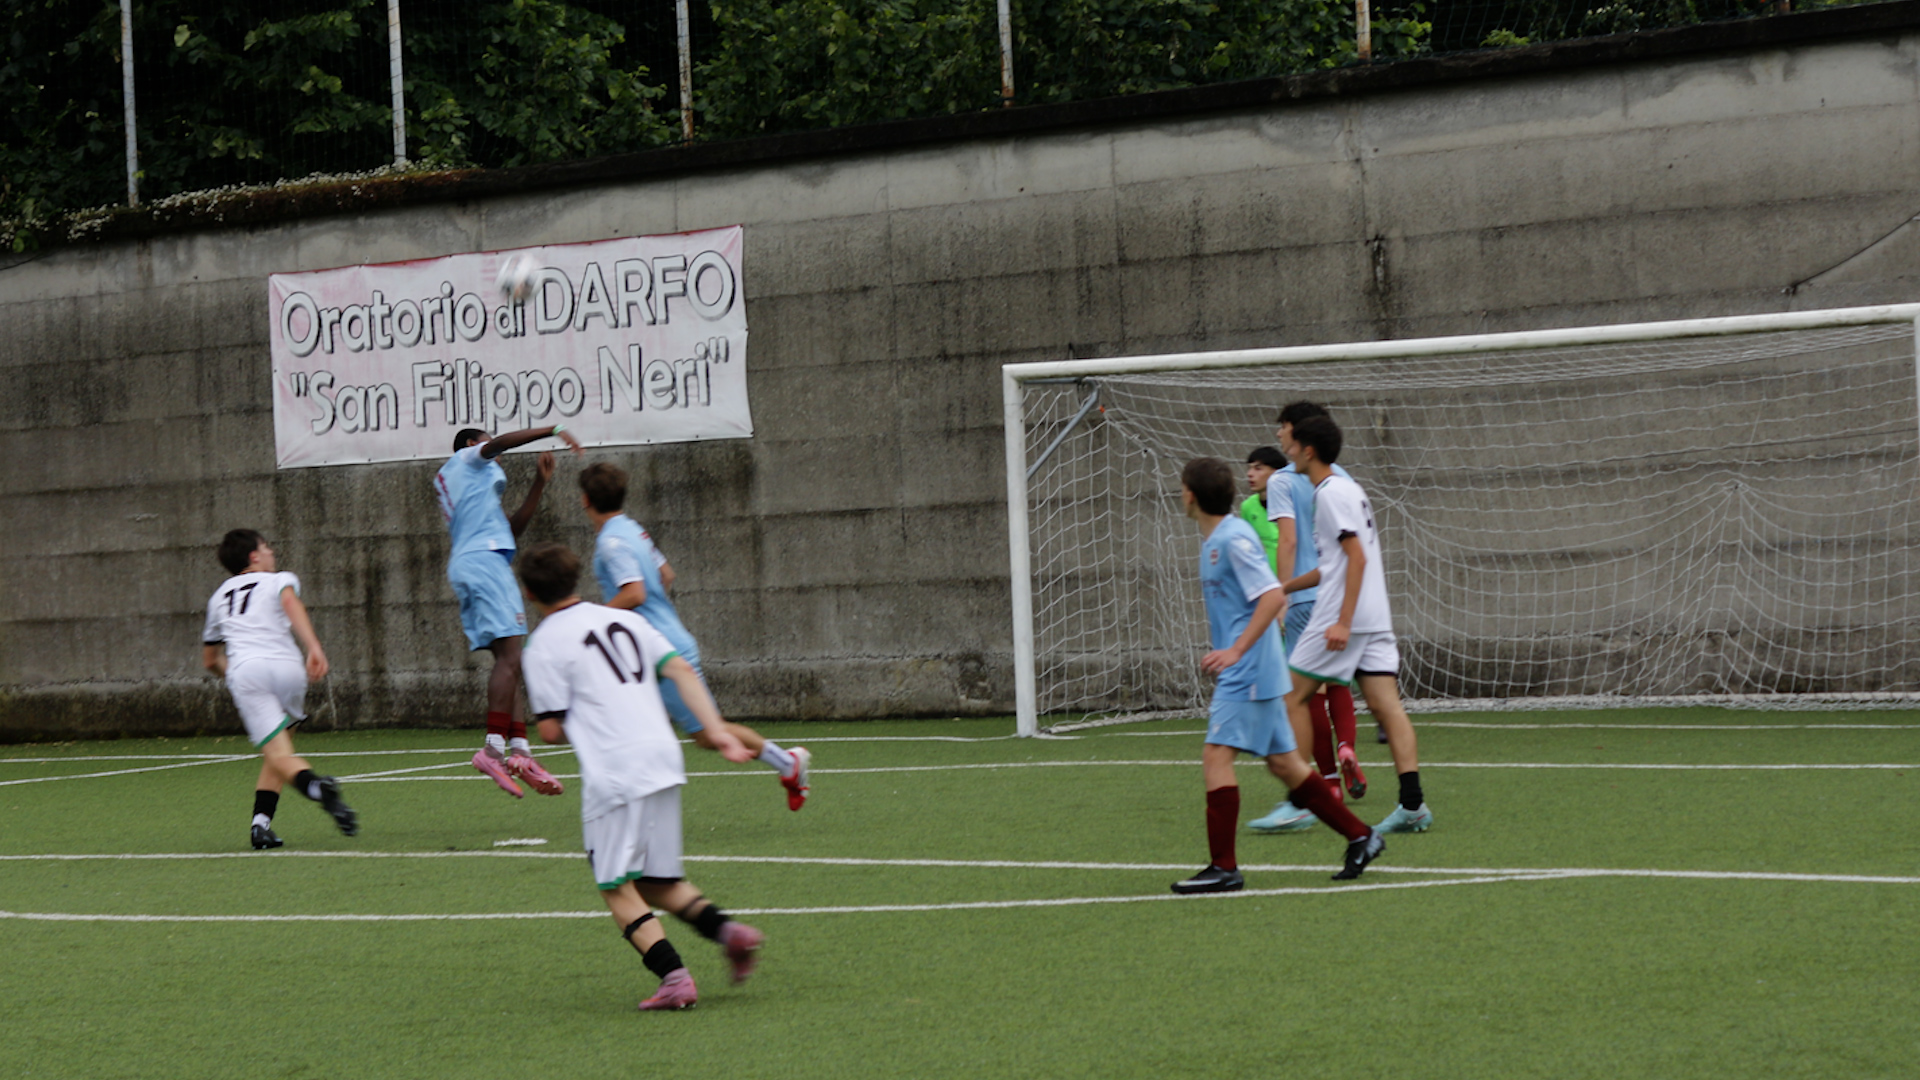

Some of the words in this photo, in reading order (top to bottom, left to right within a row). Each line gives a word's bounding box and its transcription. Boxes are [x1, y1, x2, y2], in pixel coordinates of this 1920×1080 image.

[280, 281, 487, 357] Oratorio
[494, 286, 526, 339] di
[535, 250, 736, 335] DARFO
[290, 370, 398, 435] "San
[412, 358, 585, 435] Filippo
[598, 336, 730, 413] Neri"
[223, 581, 260, 617] 17
[582, 621, 644, 684] 10
